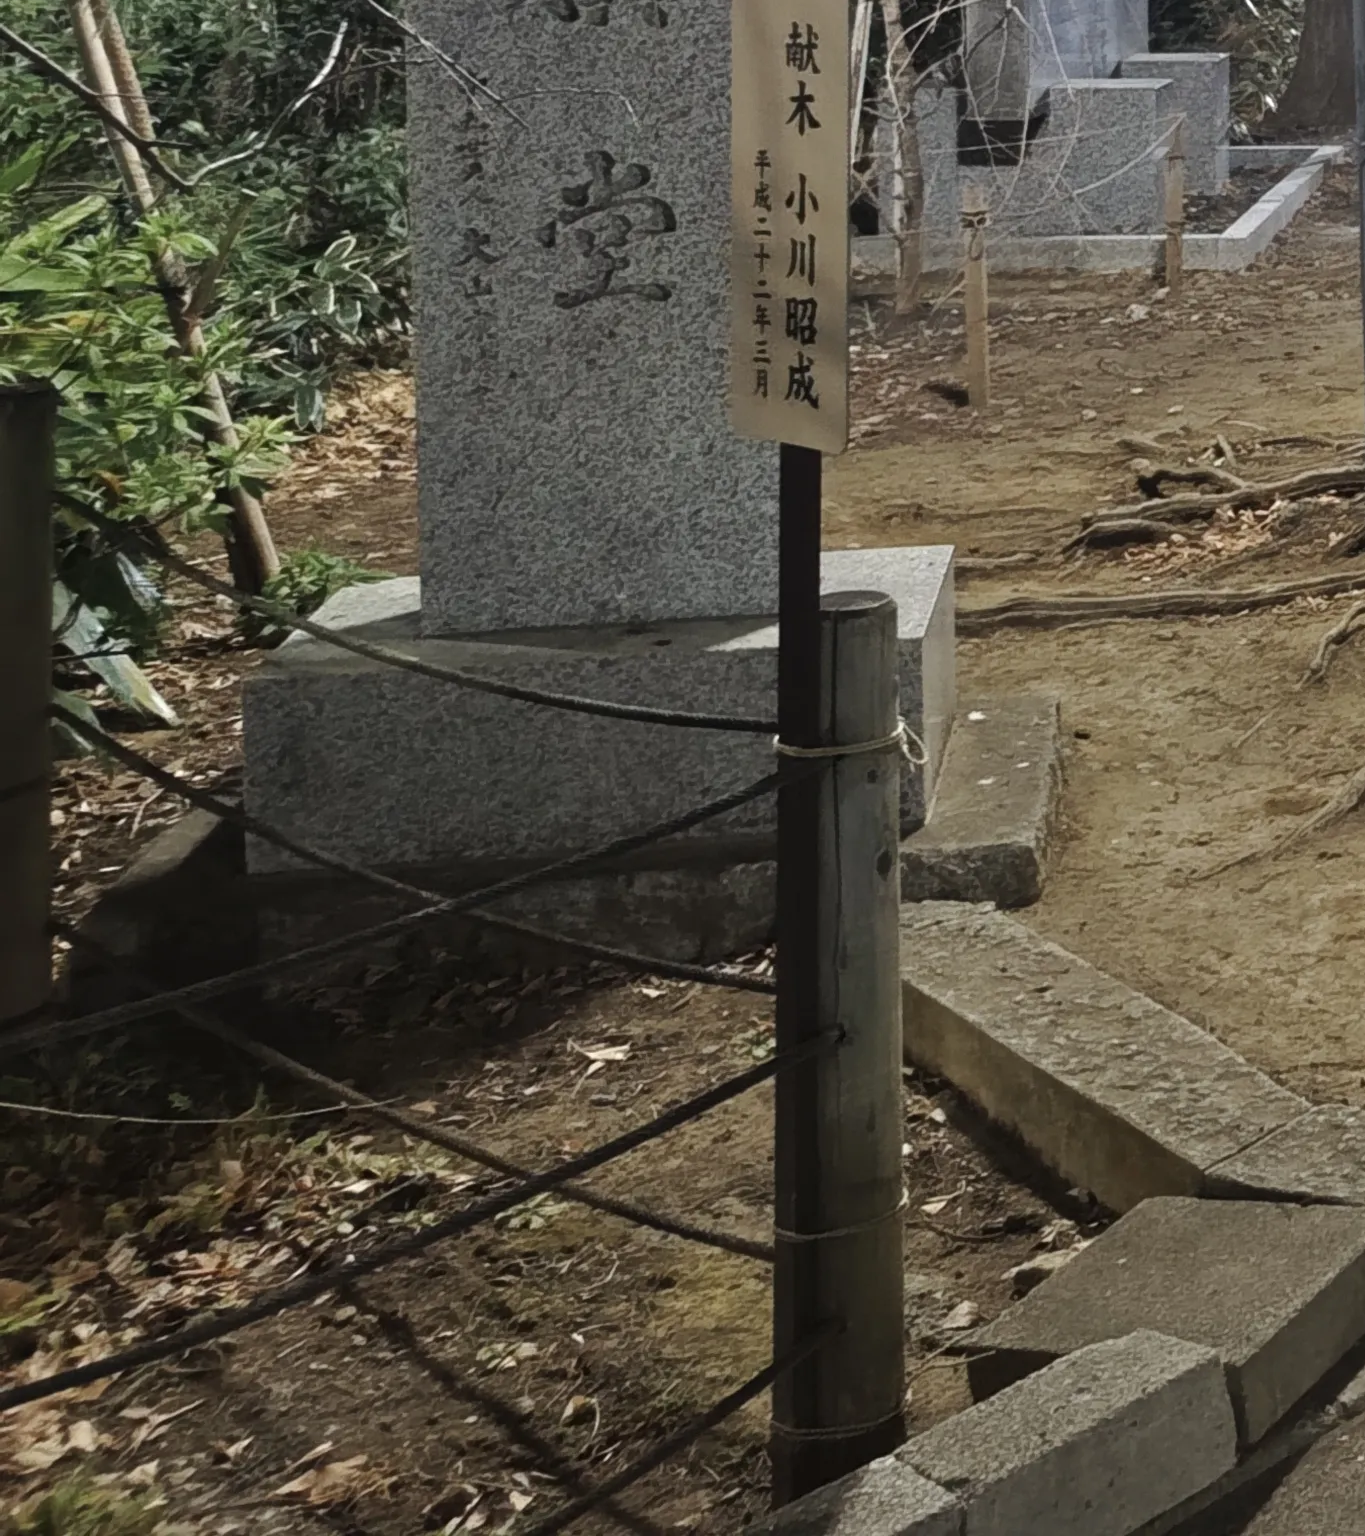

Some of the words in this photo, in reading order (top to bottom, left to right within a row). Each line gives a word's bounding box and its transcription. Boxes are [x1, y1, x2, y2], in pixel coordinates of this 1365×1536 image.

[785, 21, 821, 137] 献木
[752, 149, 772, 399] 平成二十二年三月
[784, 172, 820, 411] 小川昭成
